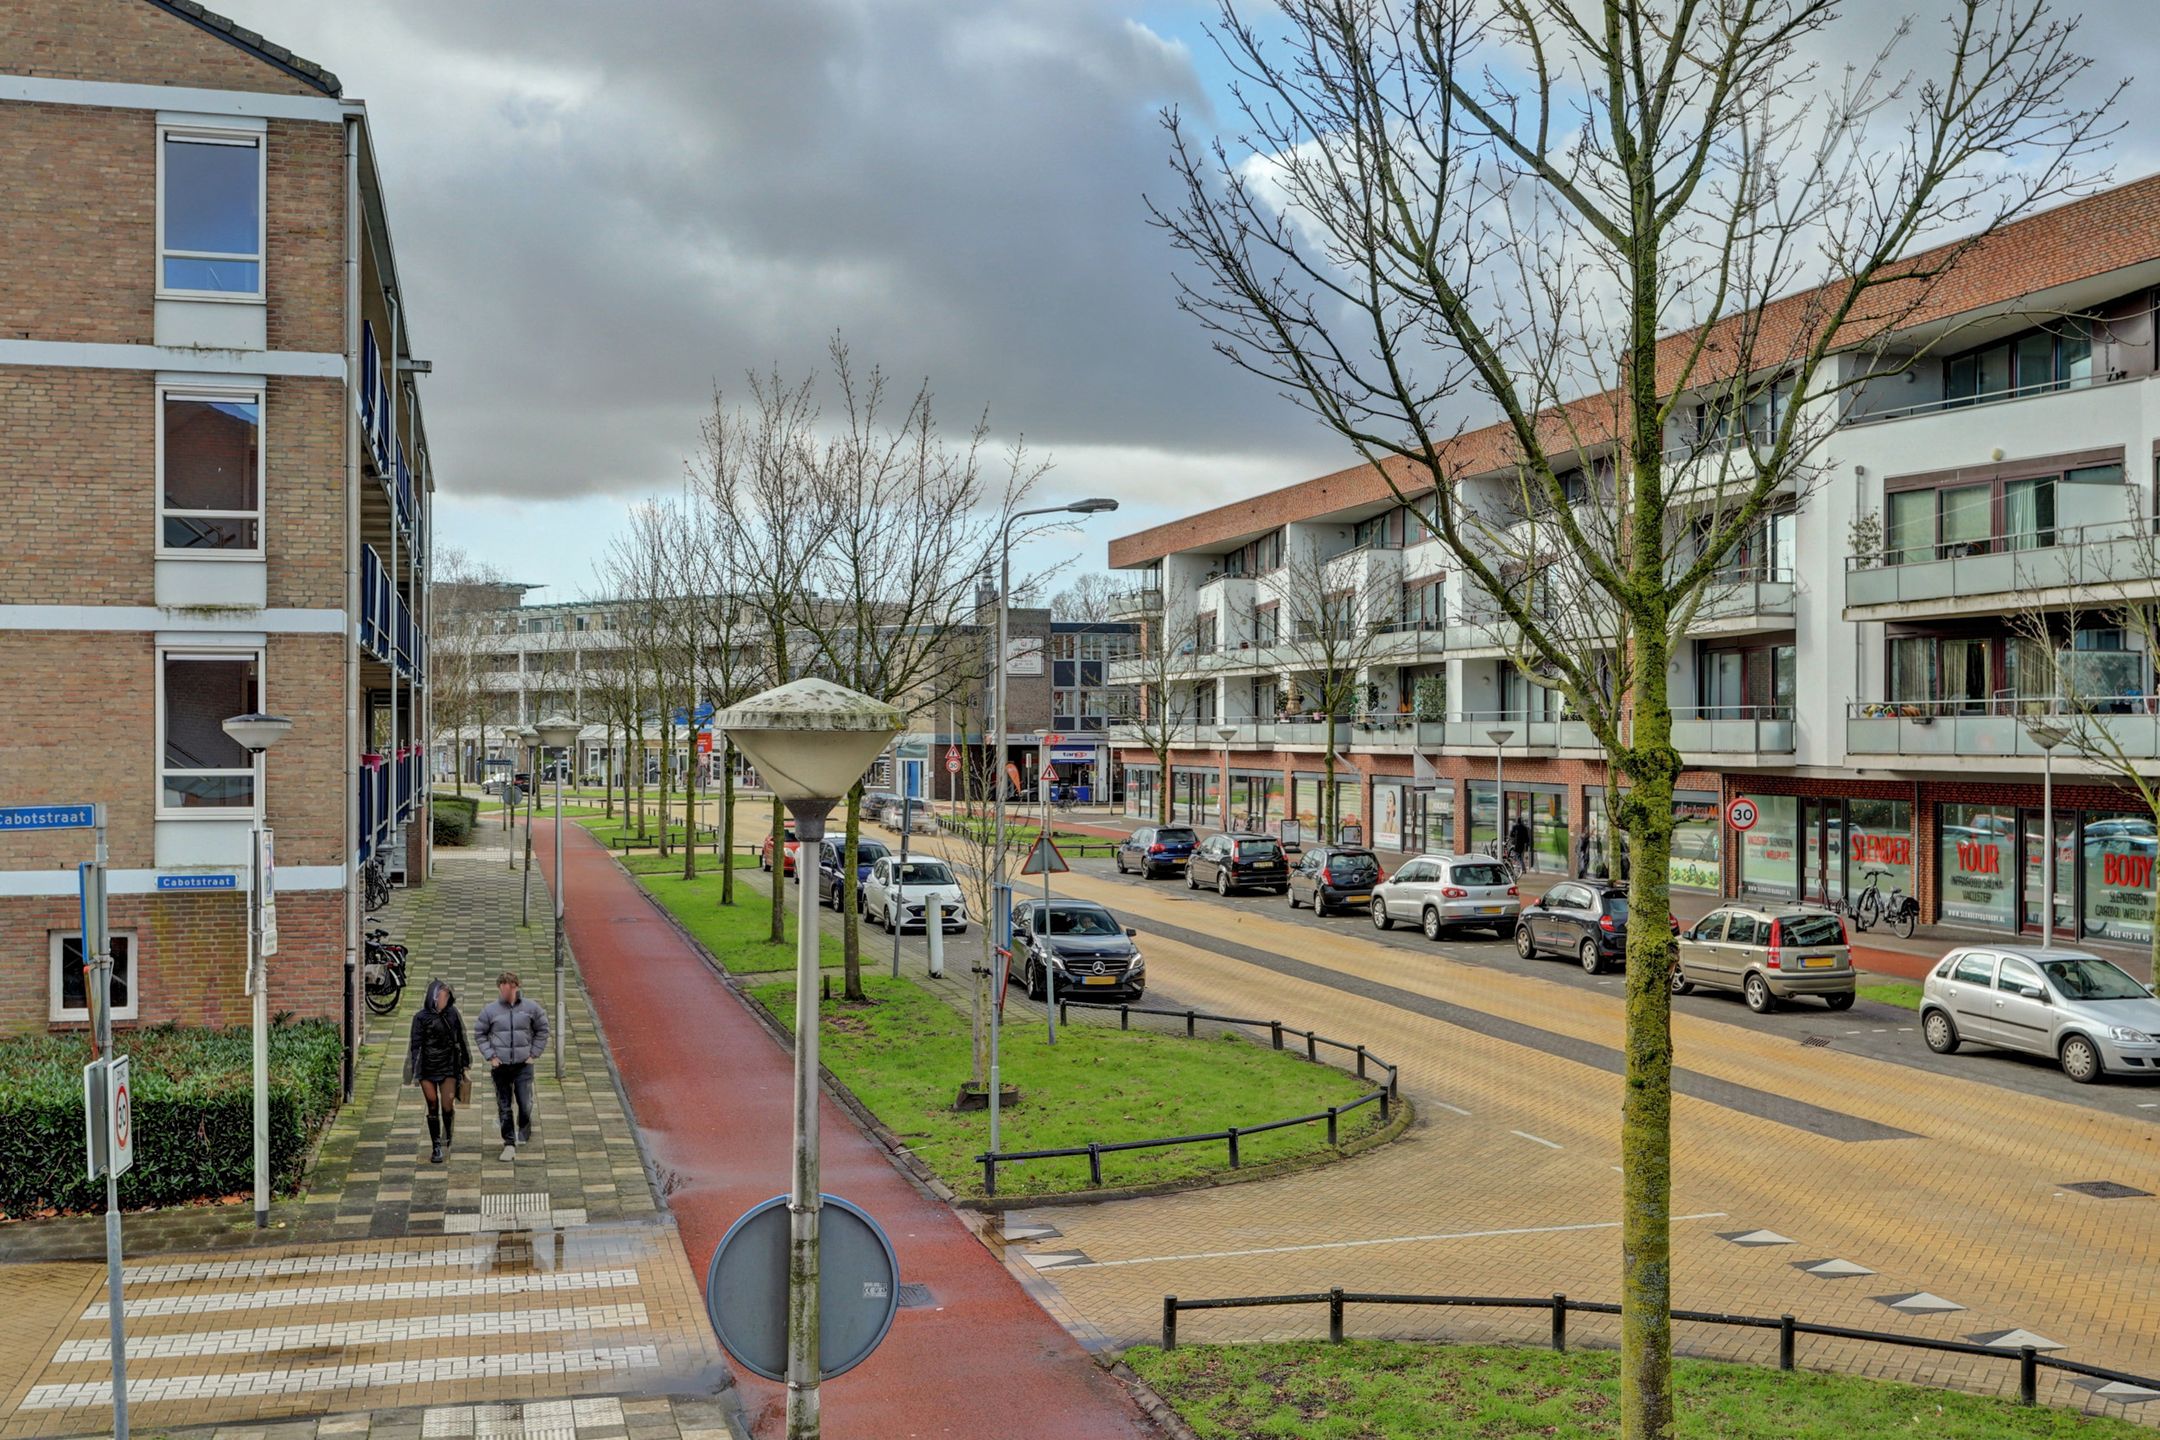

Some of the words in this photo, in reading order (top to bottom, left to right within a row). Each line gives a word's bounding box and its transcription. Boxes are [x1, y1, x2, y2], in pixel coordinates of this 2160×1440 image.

[0, 811, 86, 825] Cabotstraat
[1733, 809, 1753, 821] 30
[1850, 832, 1911, 865] SLENDER
[1956, 841, 1999, 874] YOUR
[163, 878, 230, 887] Cabotstraat
[2103, 853, 2153, 888] BODY
[118, 1103, 127, 1130] 30
